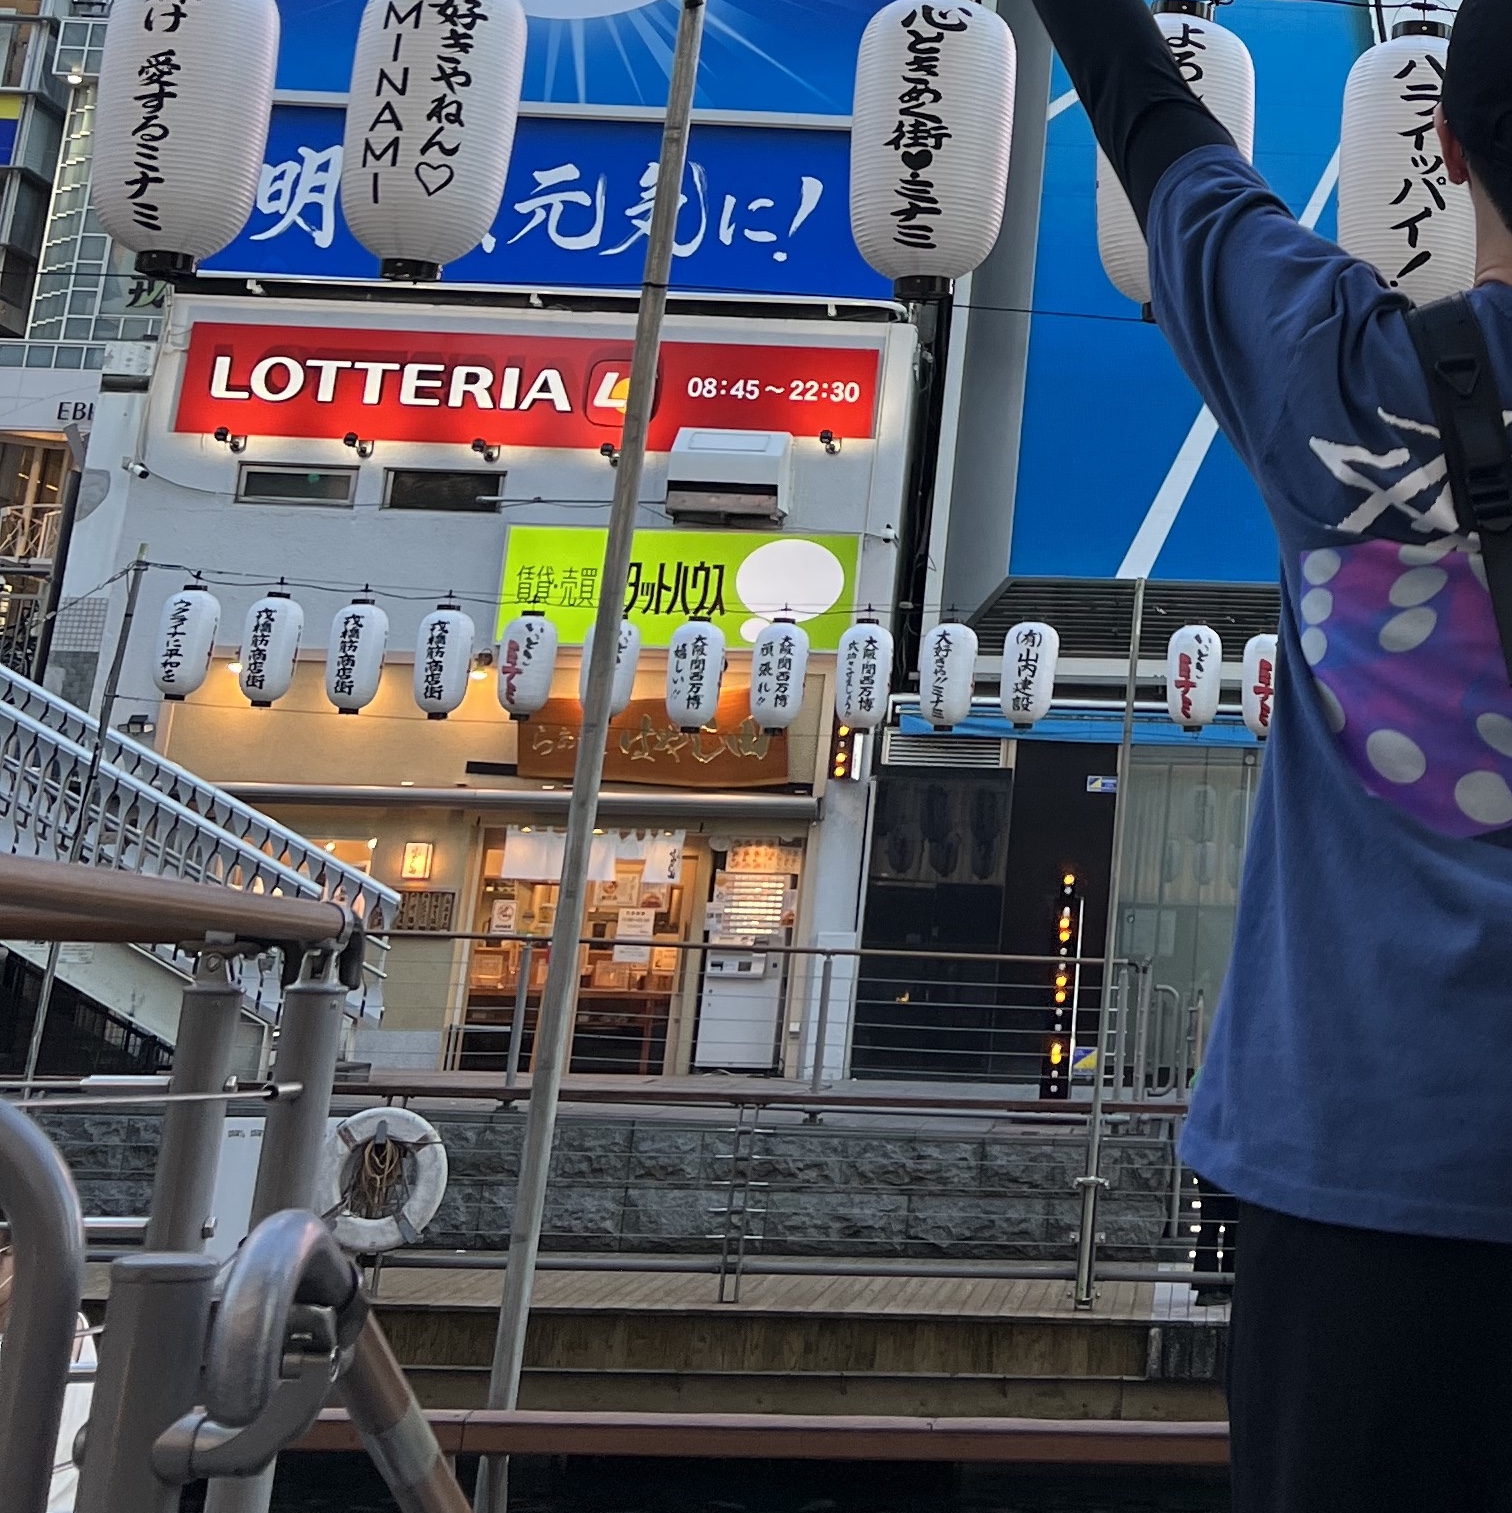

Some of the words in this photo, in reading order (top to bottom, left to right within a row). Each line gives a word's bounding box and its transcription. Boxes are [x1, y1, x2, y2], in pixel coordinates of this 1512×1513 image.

[123, 48, 183, 233] 愛するミナミ
[360, 0, 425, 206] MINAMI
[210, 355, 573, 413] LOTTERIA
